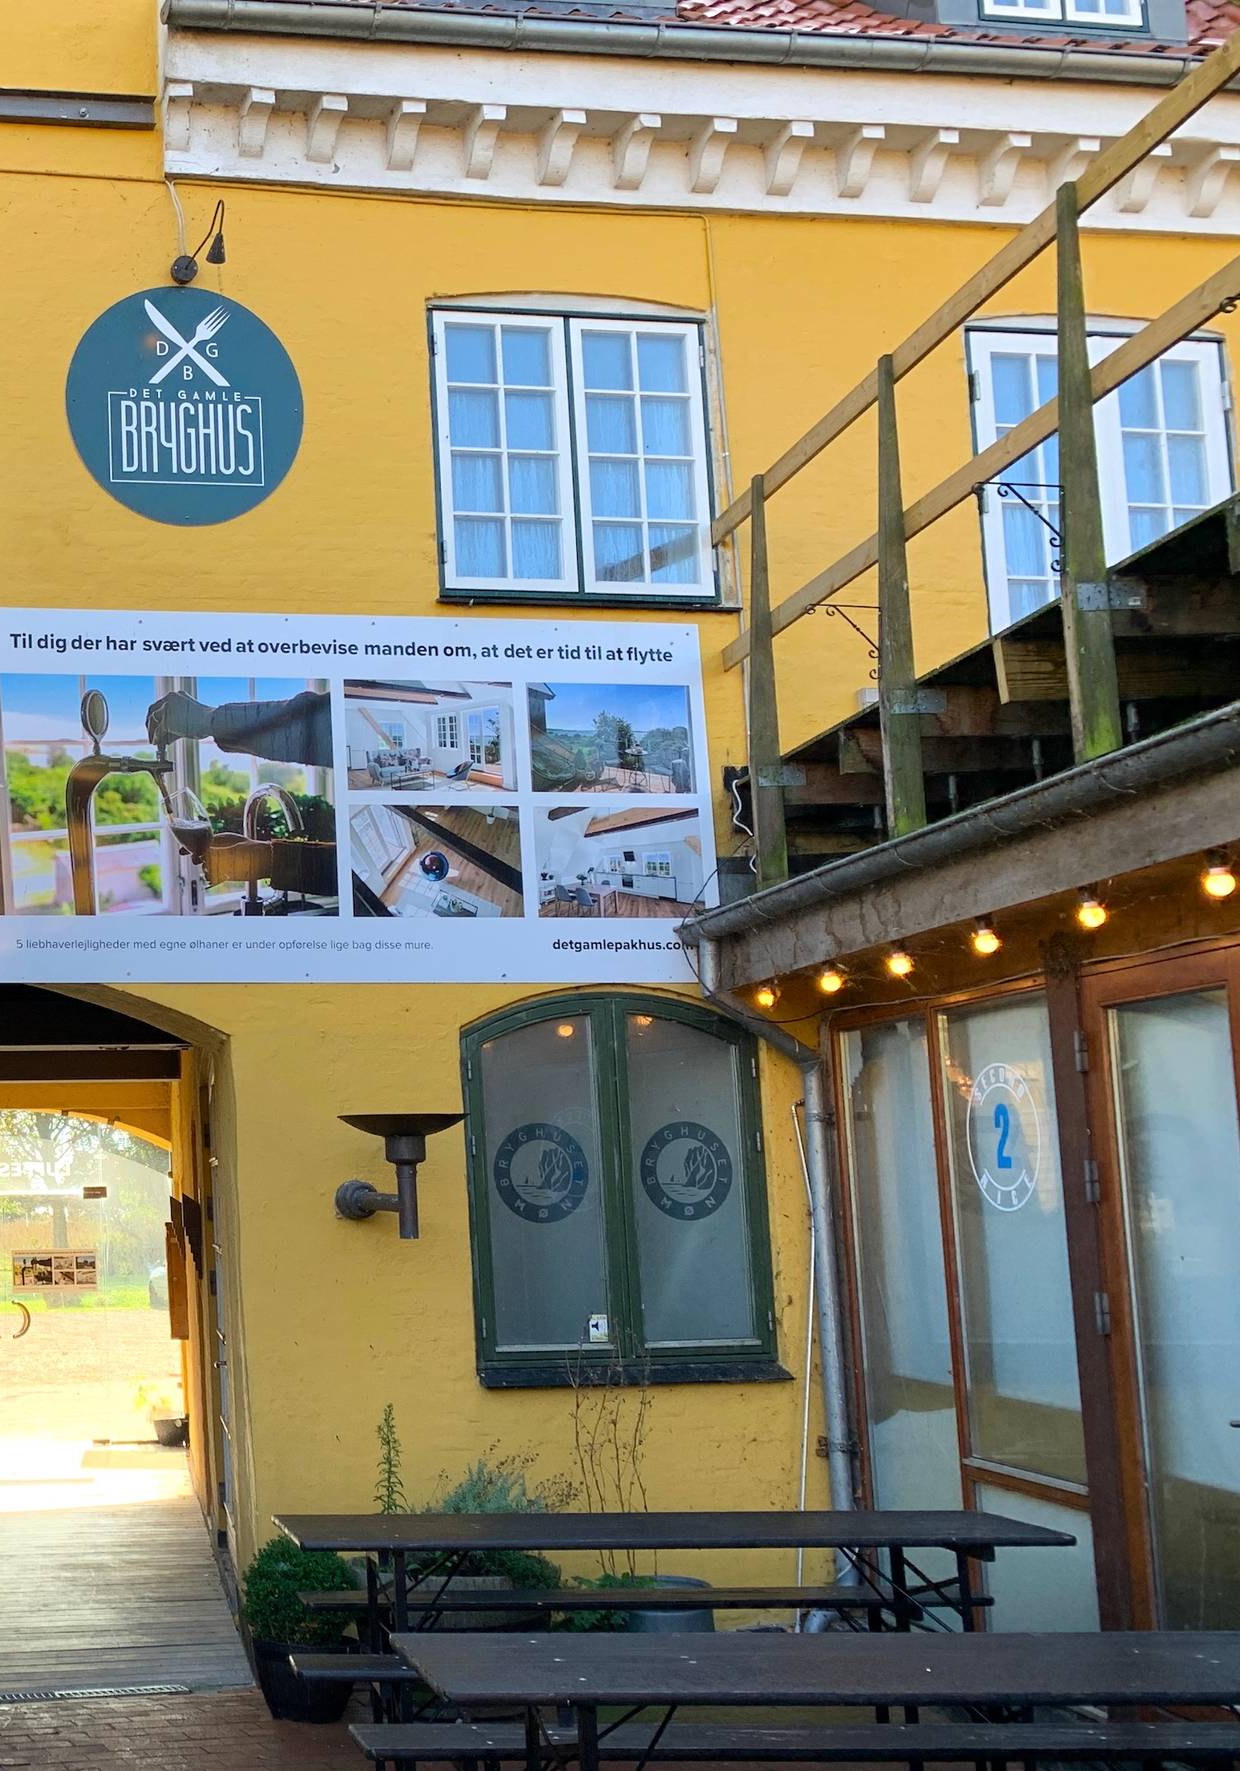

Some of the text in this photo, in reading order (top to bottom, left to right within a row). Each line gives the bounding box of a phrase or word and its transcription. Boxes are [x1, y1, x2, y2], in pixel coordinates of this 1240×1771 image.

[156, 341, 219, 358] D G
[183, 366, 193, 380] B
[129, 388, 241, 402] DET GAMLE
[120, 400, 254, 476] BRYGHUS
[10, 633, 674, 665] Til dig der har svært ved at overbevise manden om, at det er tid til at flytte
[16, 938, 434, 952] 5 liebhaverlejligheder med egne ølhaner er under opførelse lige bag disse mure.
[994, 1103, 1013, 1169] 2
[499, 1128, 584, 1187] BRYGHUSET
[646, 1126, 728, 1186] BRYGHUSET
[660, 1197, 717, 1216] MØN
